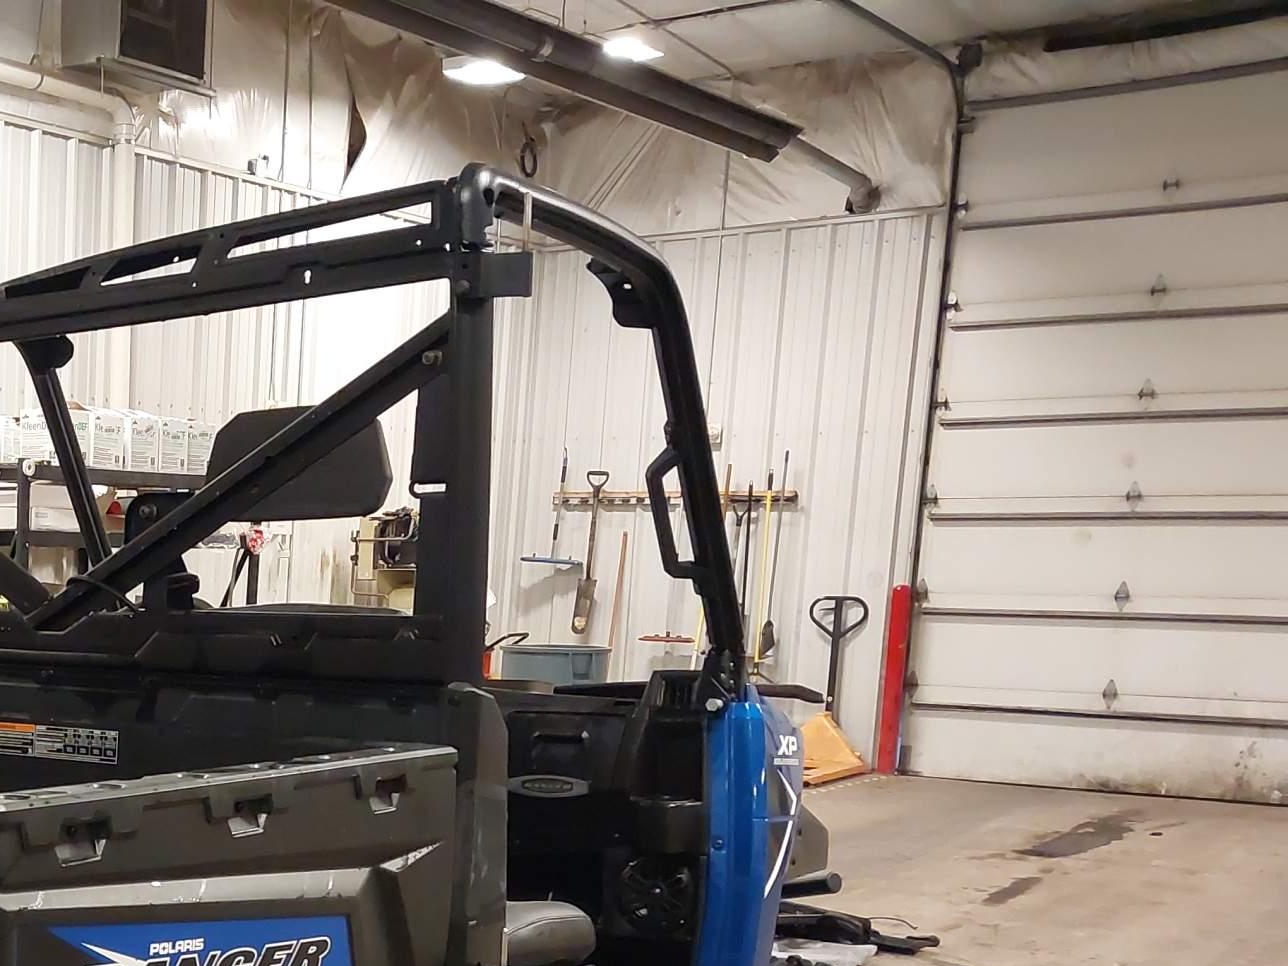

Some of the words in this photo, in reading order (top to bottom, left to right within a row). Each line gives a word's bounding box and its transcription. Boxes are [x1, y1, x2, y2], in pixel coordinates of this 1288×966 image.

[21, 421, 47, 431] KleenD
[777, 734, 798, 755] XP
[149, 938, 205, 956] POLARIS
